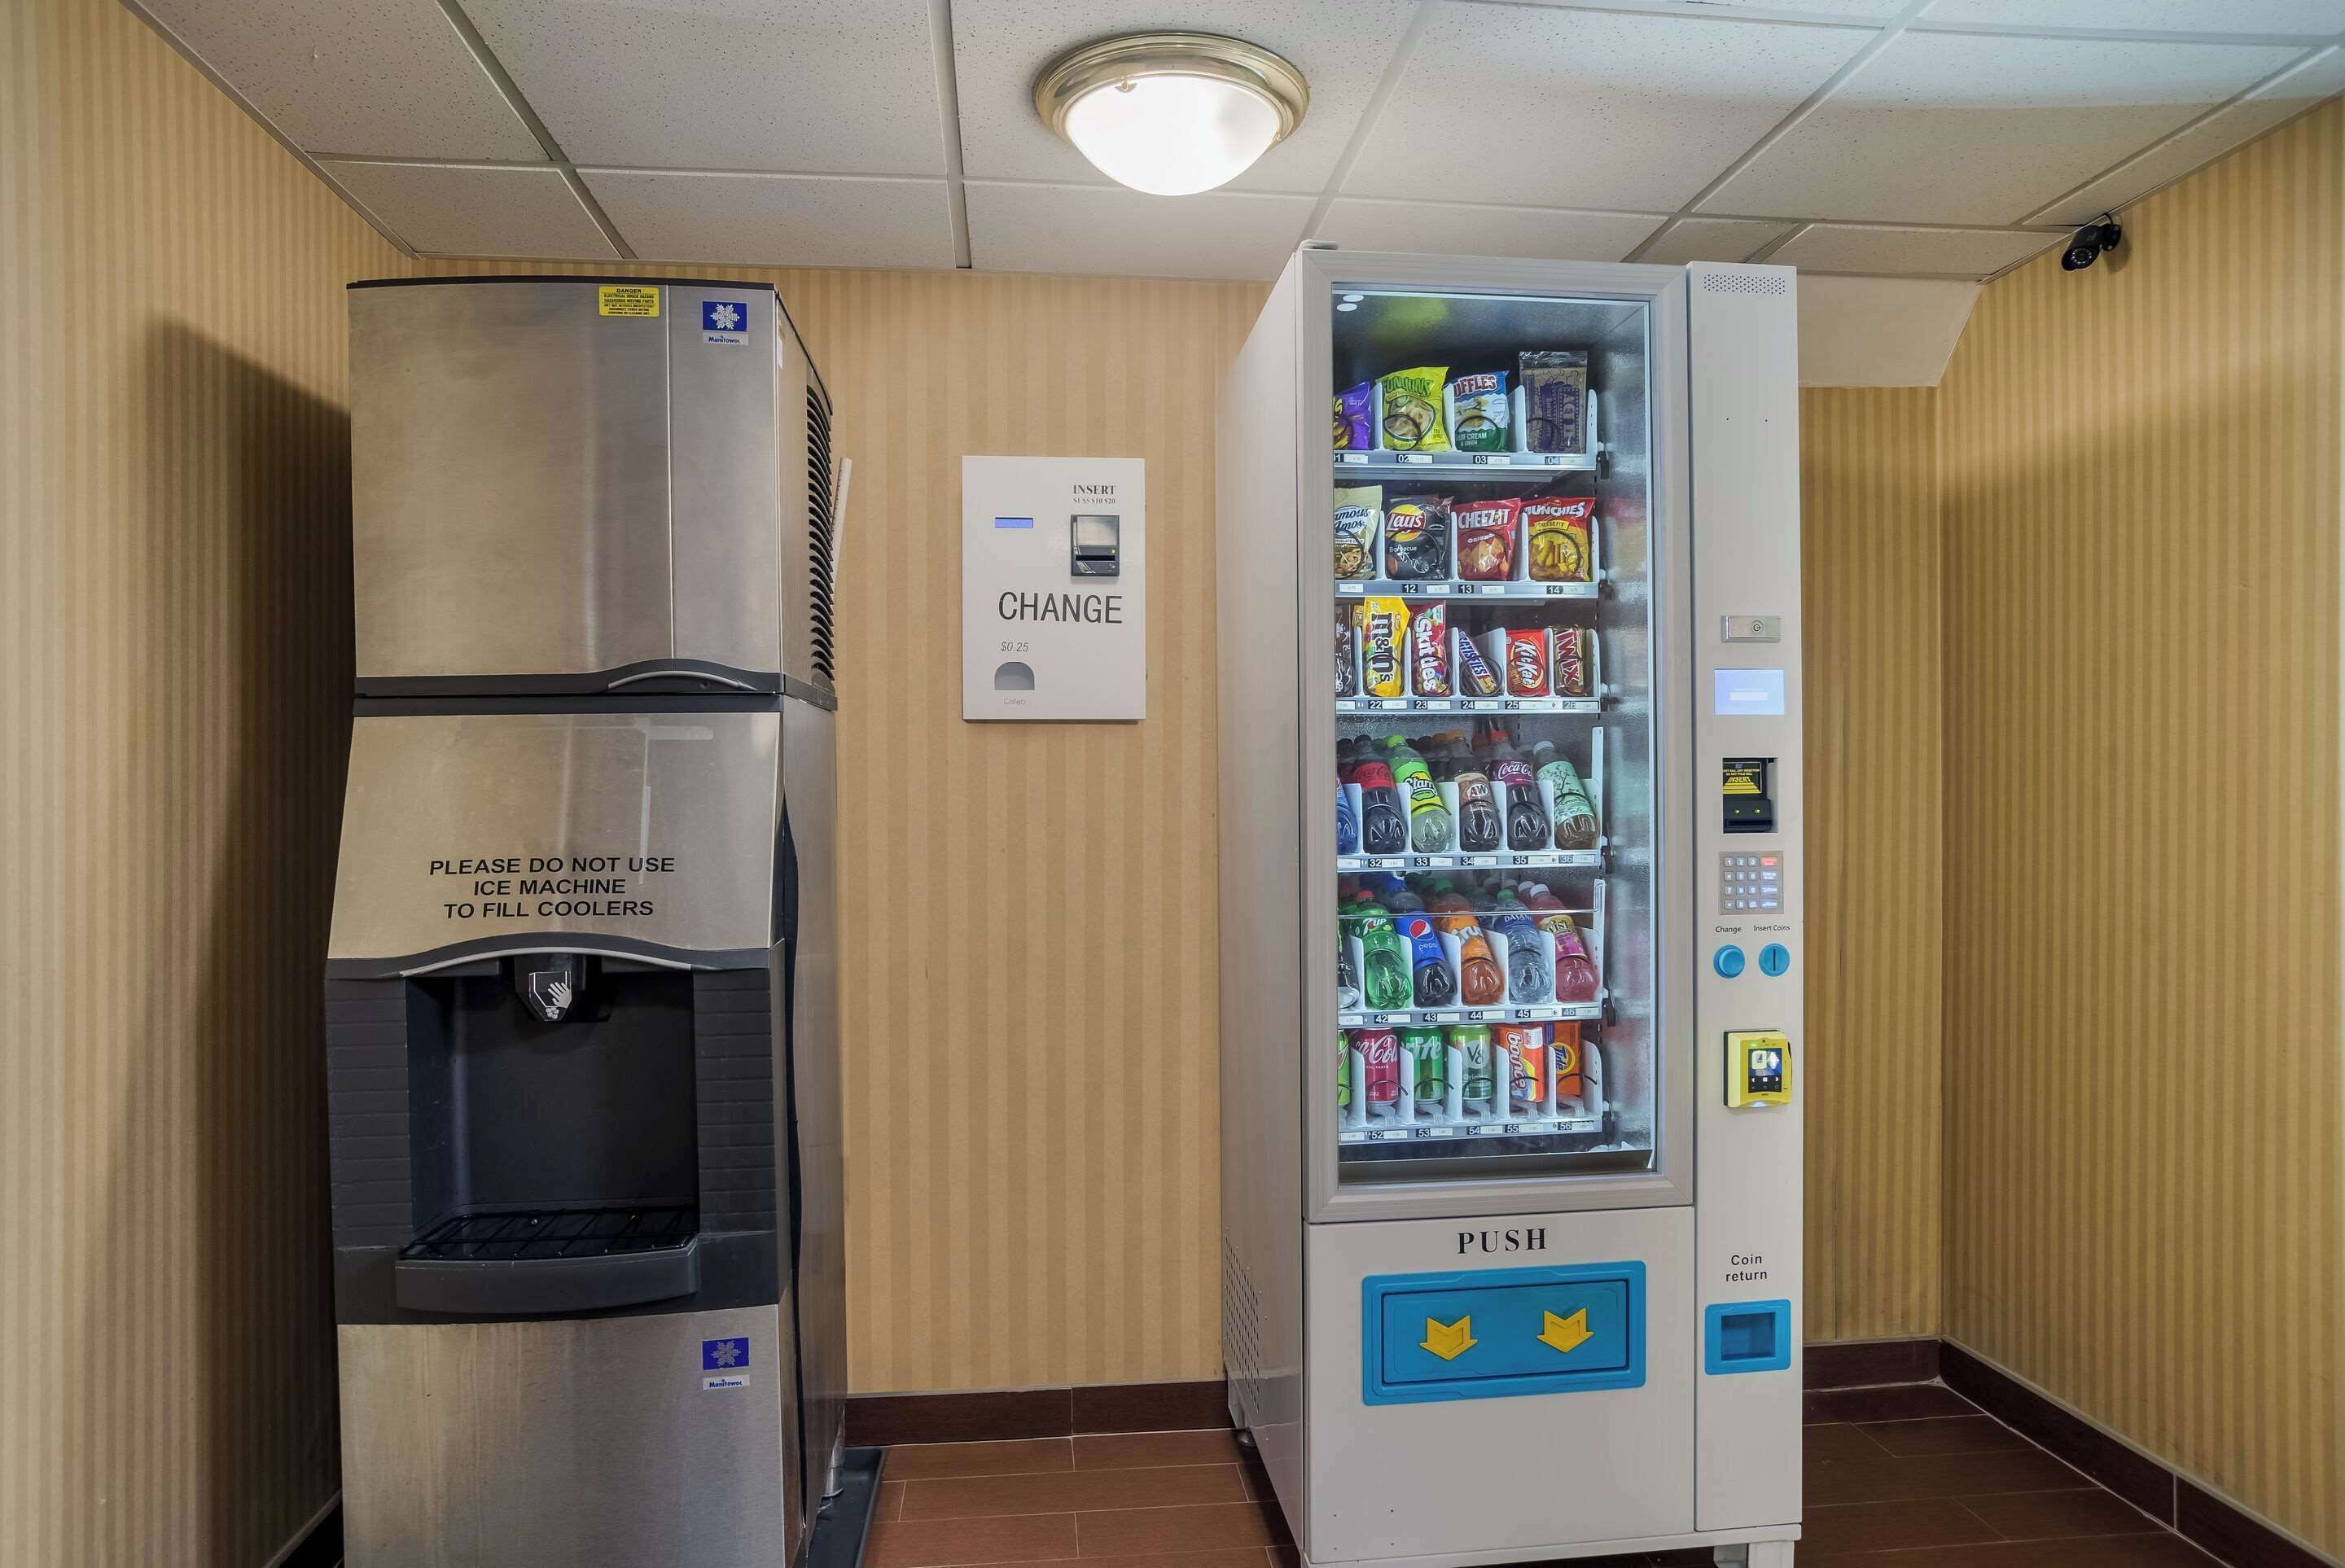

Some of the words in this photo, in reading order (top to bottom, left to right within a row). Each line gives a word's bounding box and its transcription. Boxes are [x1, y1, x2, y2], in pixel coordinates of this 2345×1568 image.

[1383, 376, 1433, 398] FUNYUNS
[1453, 374, 1497, 398] UFFLES
[1398, 455, 1409, 463] 02
[1475, 456, 1487, 464] 03
[1073, 484, 1116, 495] INSERT
[1335, 508, 1369, 521] amous
[1404, 584, 1417, 593] 12
[1460, 585, 1472, 593] 13
[1549, 586, 1560, 594] 14
[998, 591, 1123, 624] CHANGE
[1000, 642, 1029, 653] $0.25
[1414, 611, 1439, 691] Skittles
[1370, 701, 1382, 709] 22
[1416, 701, 1427, 709] 23
[1462, 701, 1474, 709] 24
[1507, 701, 1519, 709] 25
[1369, 858, 1382, 867] 32
[1416, 857, 1428, 866] 33
[1462, 856, 1474, 865] 34
[1514, 856, 1527, 864] 35
[429, 858, 521, 876] PLEASE
[529, 857, 563, 874] DO
[572, 857, 620, 873] NOT
[628, 856, 676, 873] USE
[474, 879, 511, 896] ICE
[519, 878, 626, 896] MACHINE
[444, 902, 475, 919] TO
[483, 901, 529, 918] FILL
[537, 900, 654, 917] COOLERS
[1504, 913, 1531, 922] DASAN
[1716, 926, 1742, 935] Change
[1418, 942, 1438, 955] peps
[1375, 1014, 1387, 1023] 42
[1425, 1013, 1437, 1022] 43
[1470, 1011, 1483, 1019] 44
[1518, 1010, 1530, 1018] 45
[1466, 1045, 1484, 1064] V8
[1371, 1131, 1383, 1139] 52
[1469, 1127, 1480, 1135] 54
[1457, 1228, 1547, 1255] PUSH
[1731, 1254, 1762, 1265] Coin
[1725, 1271, 1768, 1282] return
